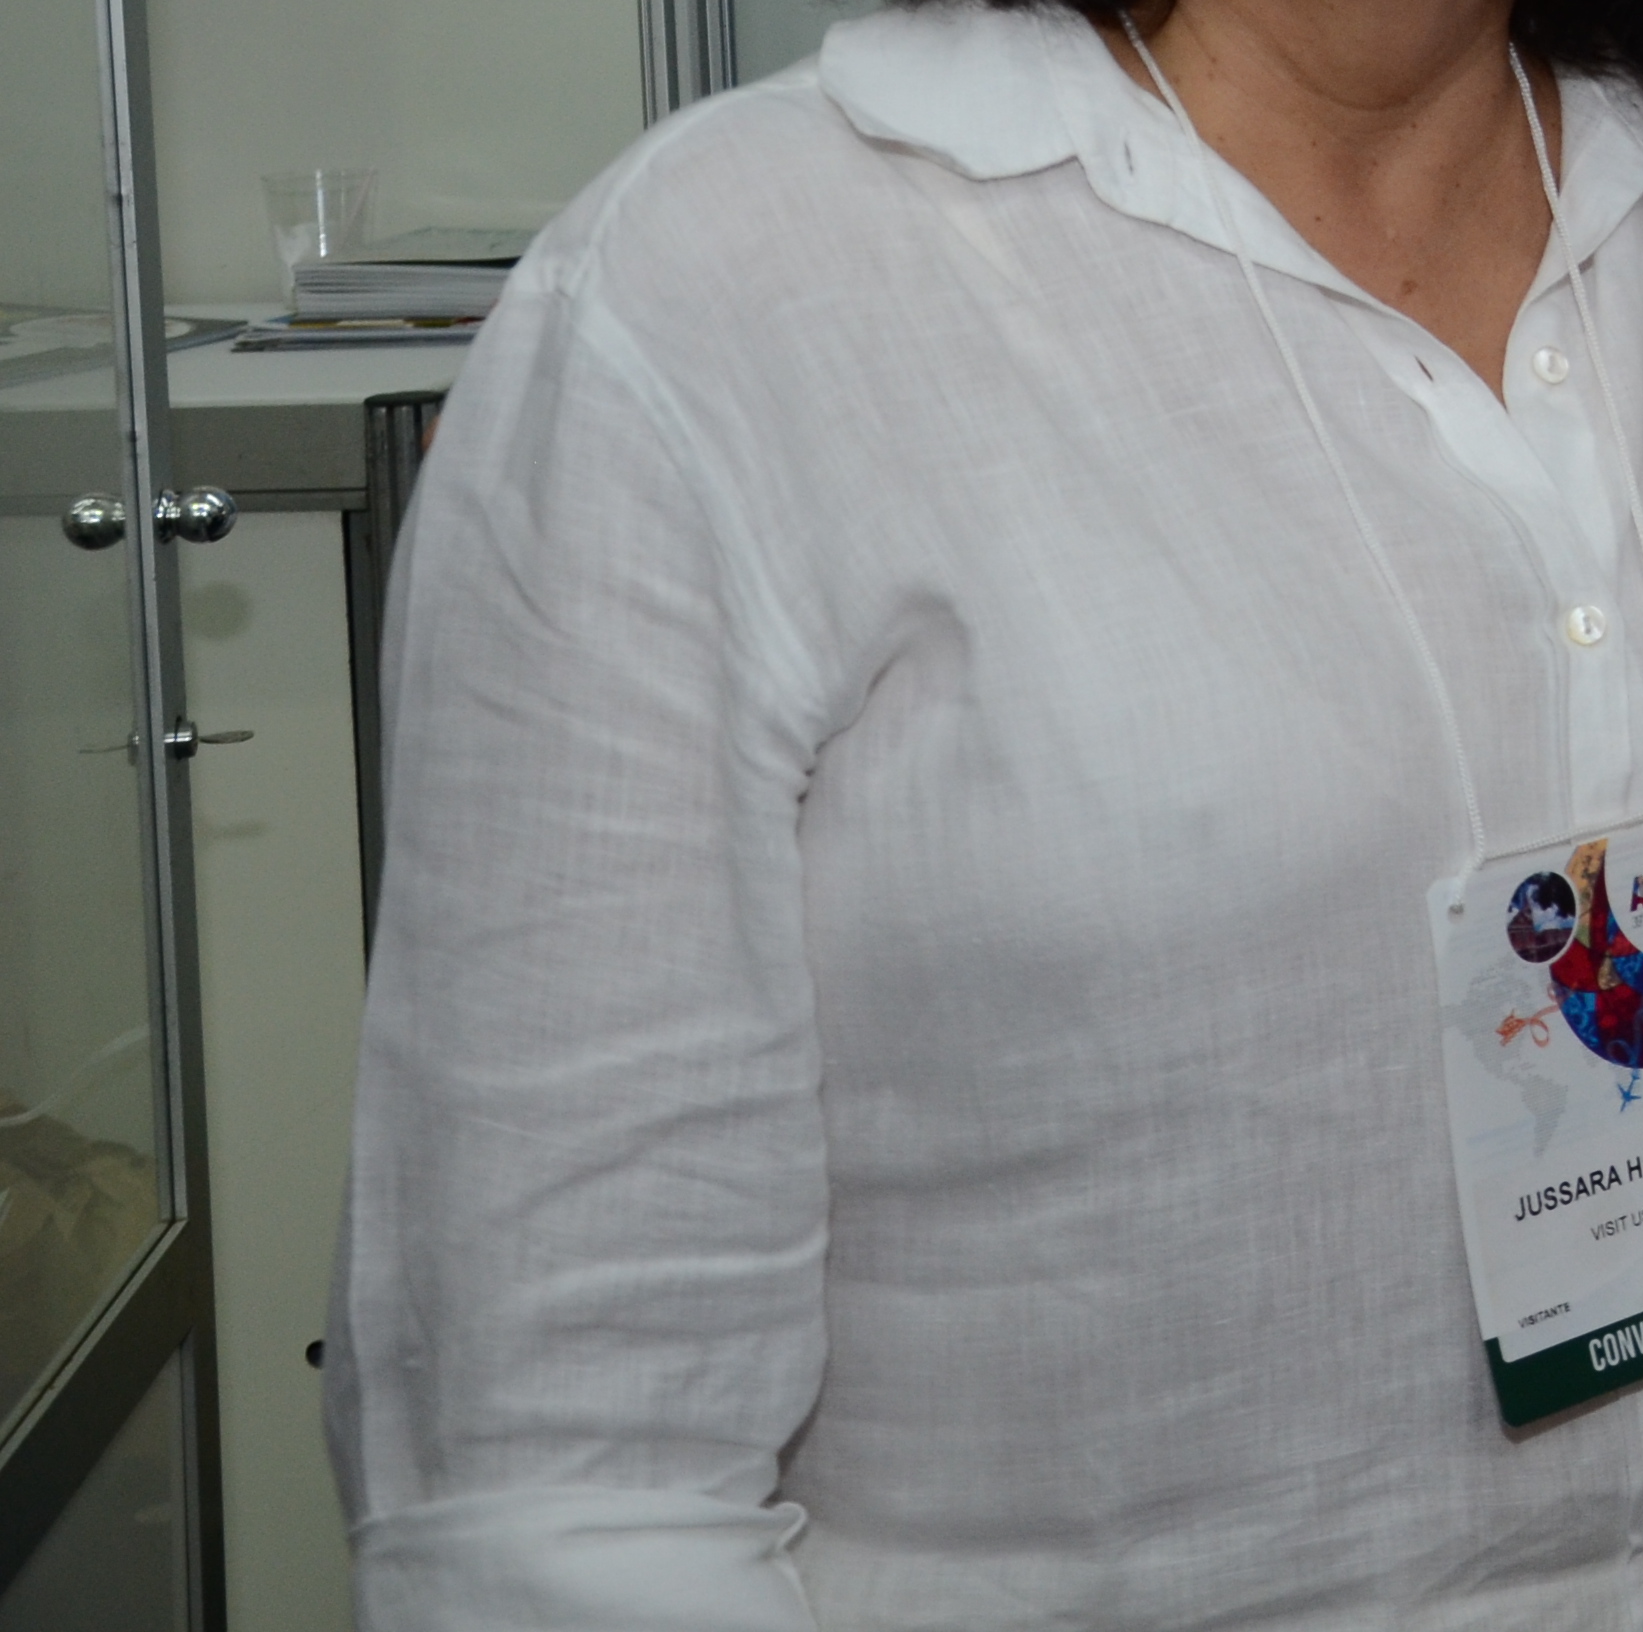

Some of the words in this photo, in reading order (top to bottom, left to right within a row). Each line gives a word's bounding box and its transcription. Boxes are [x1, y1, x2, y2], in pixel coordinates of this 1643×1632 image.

[1514, 1165, 1623, 1222] JUSSARA
[1590, 1215, 1628, 1242] VISIT
[1518, 1301, 1572, 1329] VISITANTE
